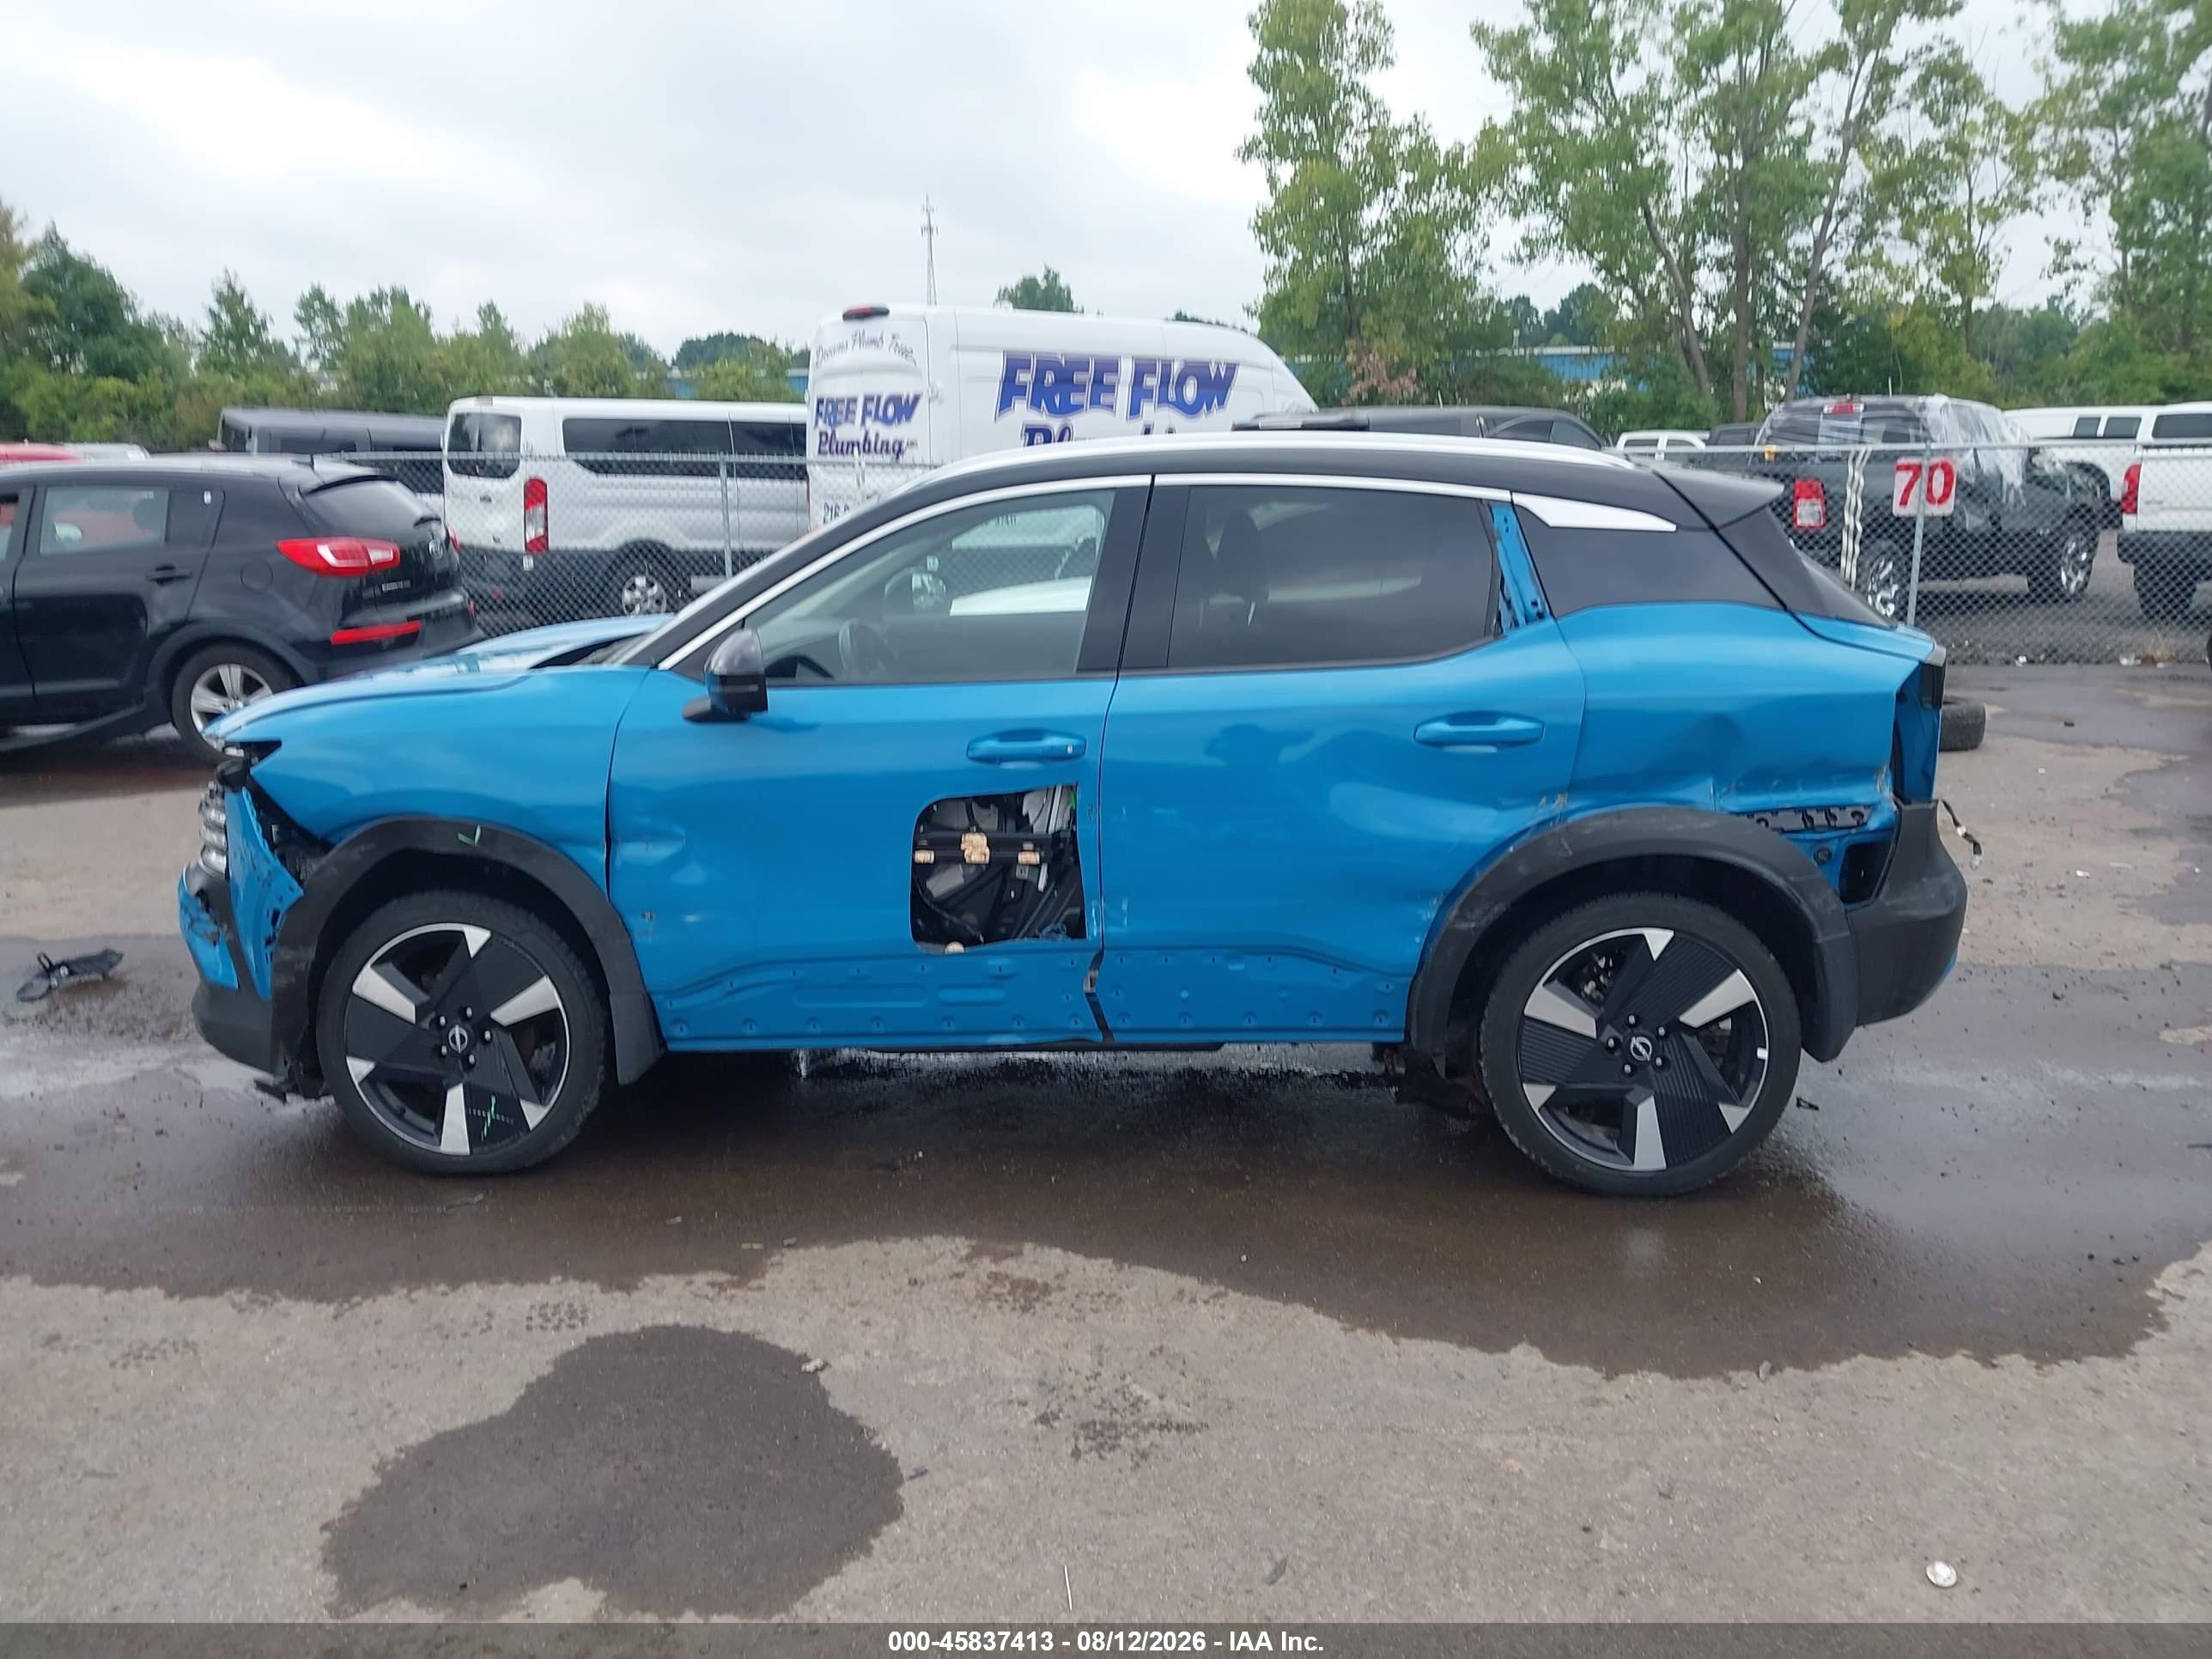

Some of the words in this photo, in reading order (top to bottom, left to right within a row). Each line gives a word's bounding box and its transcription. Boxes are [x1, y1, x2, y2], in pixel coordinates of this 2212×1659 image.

[994, 350, 1121, 422] FREE
[1126, 356, 1241, 422] FLOW
[813, 395, 858, 429] FREE
[860, 392, 922, 428] FLOW
[817, 429, 904, 461] Plumbing
[1895, 459, 1954, 507] 70
